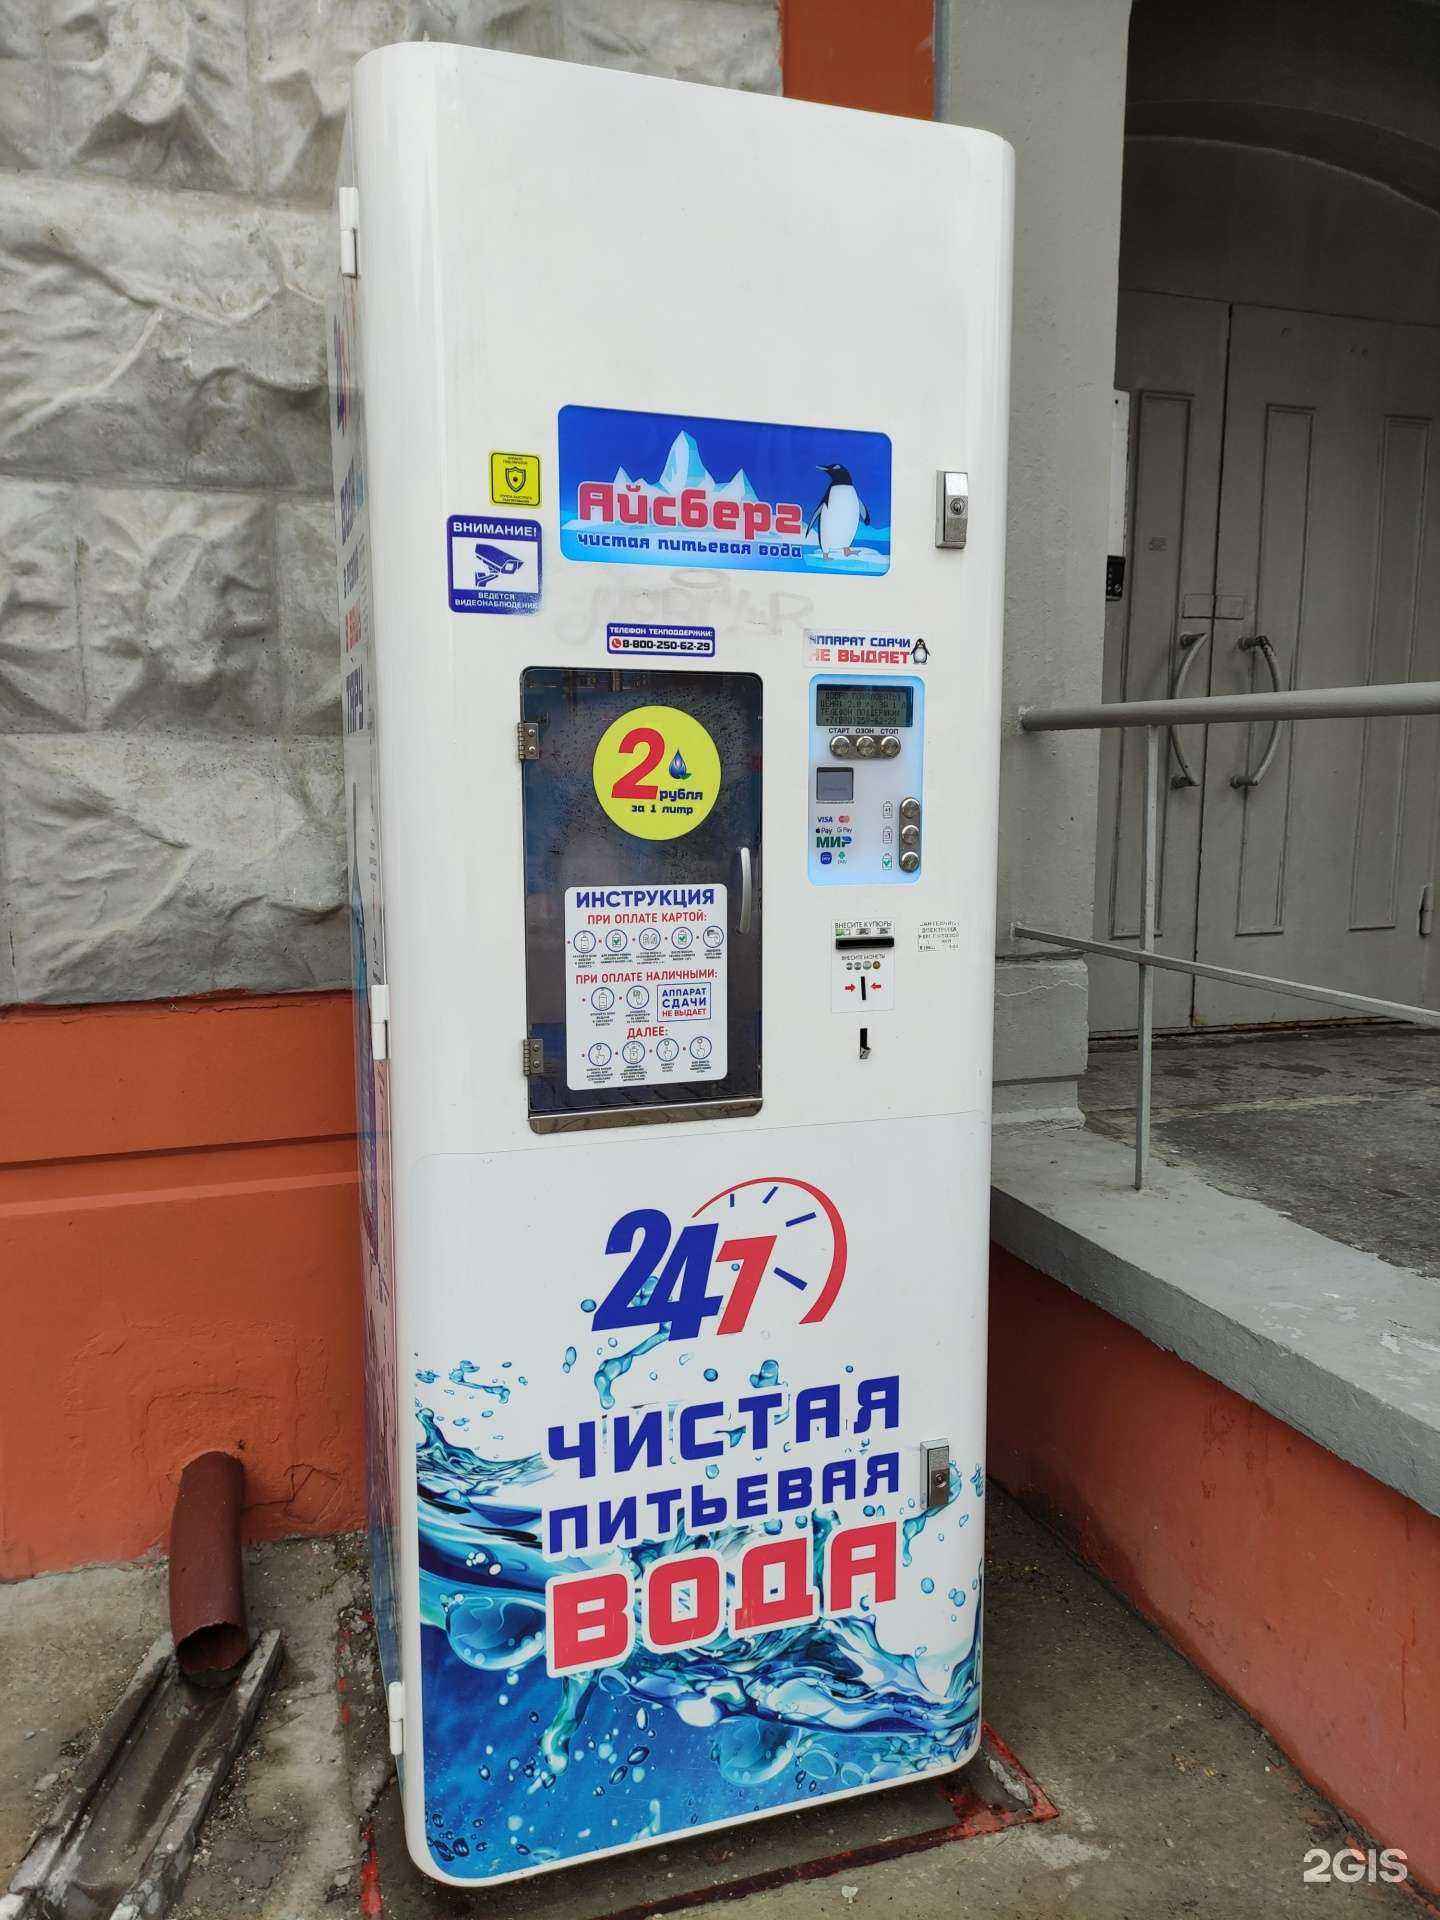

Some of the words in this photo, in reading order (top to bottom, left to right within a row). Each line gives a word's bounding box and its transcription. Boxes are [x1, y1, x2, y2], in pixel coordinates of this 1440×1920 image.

[578, 482, 802, 540] Айсберг
[453, 521, 538, 537] ВНИМАНИЕ!
[577, 532, 650, 549] чистая
[658, 537, 752, 555] питьевая
[758, 543, 802, 558] вода
[609, 626, 647, 635] ТЕЛЕФОН
[622, 639, 711, 651] 8-800-250-62-29
[870, 637, 911, 648] СДАЧИ
[837, 649, 910, 664] ВЫДАЕТ
[611, 727, 666, 800] 2
[659, 788, 704, 802] рубля
[631, 804, 645, 813] за
[650, 804, 657, 813] 1
[662, 805, 694, 815] литр
[817, 815, 833, 823] VISA
[816, 835, 853, 849] МИР
[576, 888, 715, 909] ИНСТРУКЦИЯ
[587, 913, 611, 925] ПРИ
[614, 912, 658, 925] ОПЛАТЕ
[661, 909, 708, 923] КАРТОЙ:
[575, 974, 598, 985] ПРИ
[601, 972, 643, 983] ОПЛАТЕ
[646, 968, 718, 981] НАЛИЧНЫМИ:
[661, 987, 707, 997] АППАРАТ
[662, 997, 707, 1009] СДАЧИ
[662, 1009, 674, 1017] НЕ
[676, 1008, 707, 1017] ВЫДАЕТ
[626, 1025, 670, 1040] ДАЛЕЕ:
[547, 1374, 900, 1479] ЧИСТАЯ
[548, 1451, 900, 1554] ПИТЬЕВАЯ
[552, 1521, 898, 1670] ВОДА
